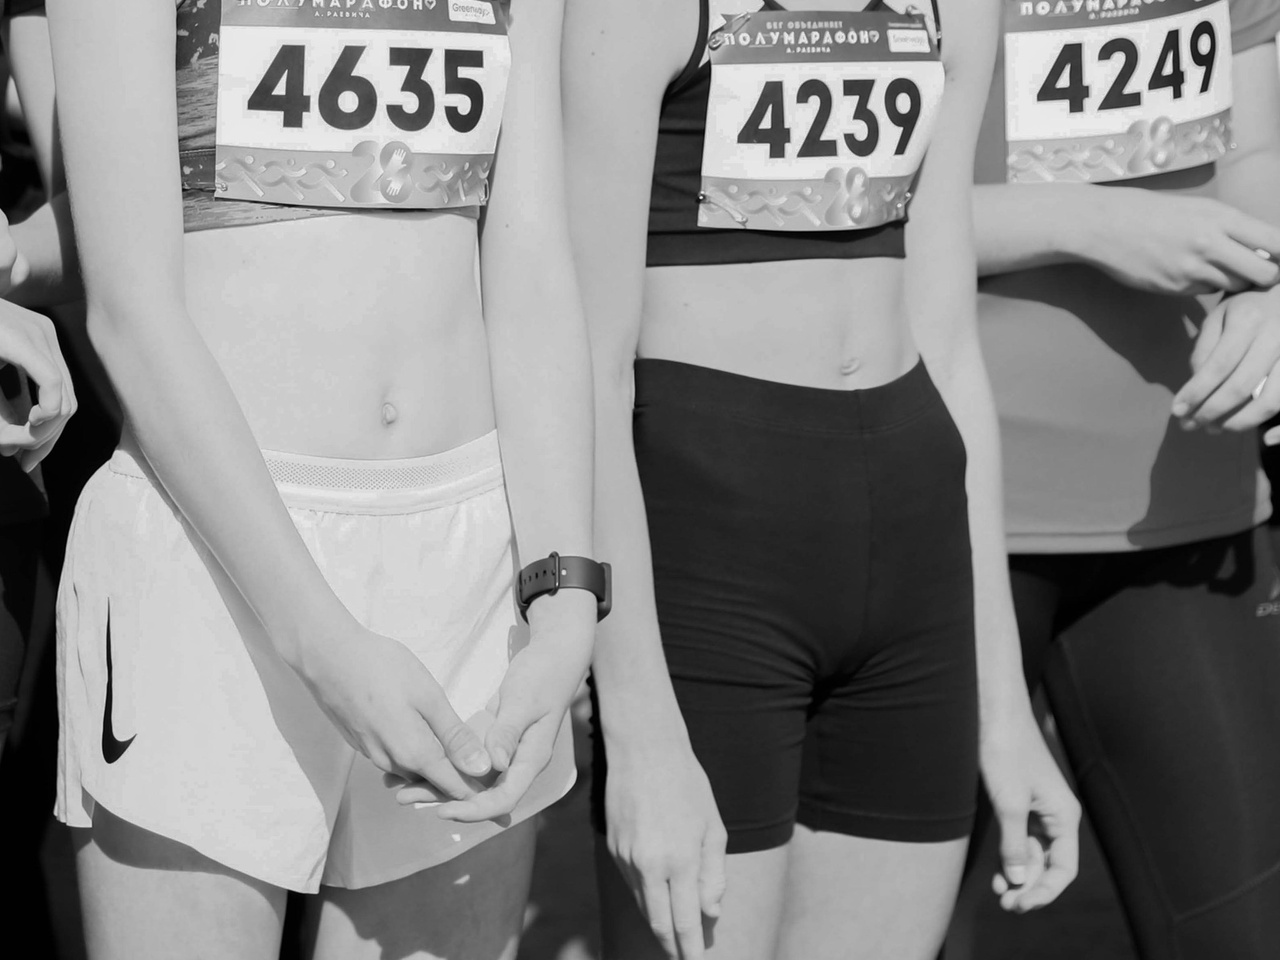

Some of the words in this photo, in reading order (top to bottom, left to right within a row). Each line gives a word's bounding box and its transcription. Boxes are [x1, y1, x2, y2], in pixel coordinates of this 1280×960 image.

[724, 29, 869, 46] ПОЛУМАРАФОН
[1037, 20, 1216, 114] 4249
[247, 44, 484, 133] 4635
[737, 78, 921, 159] 4239
